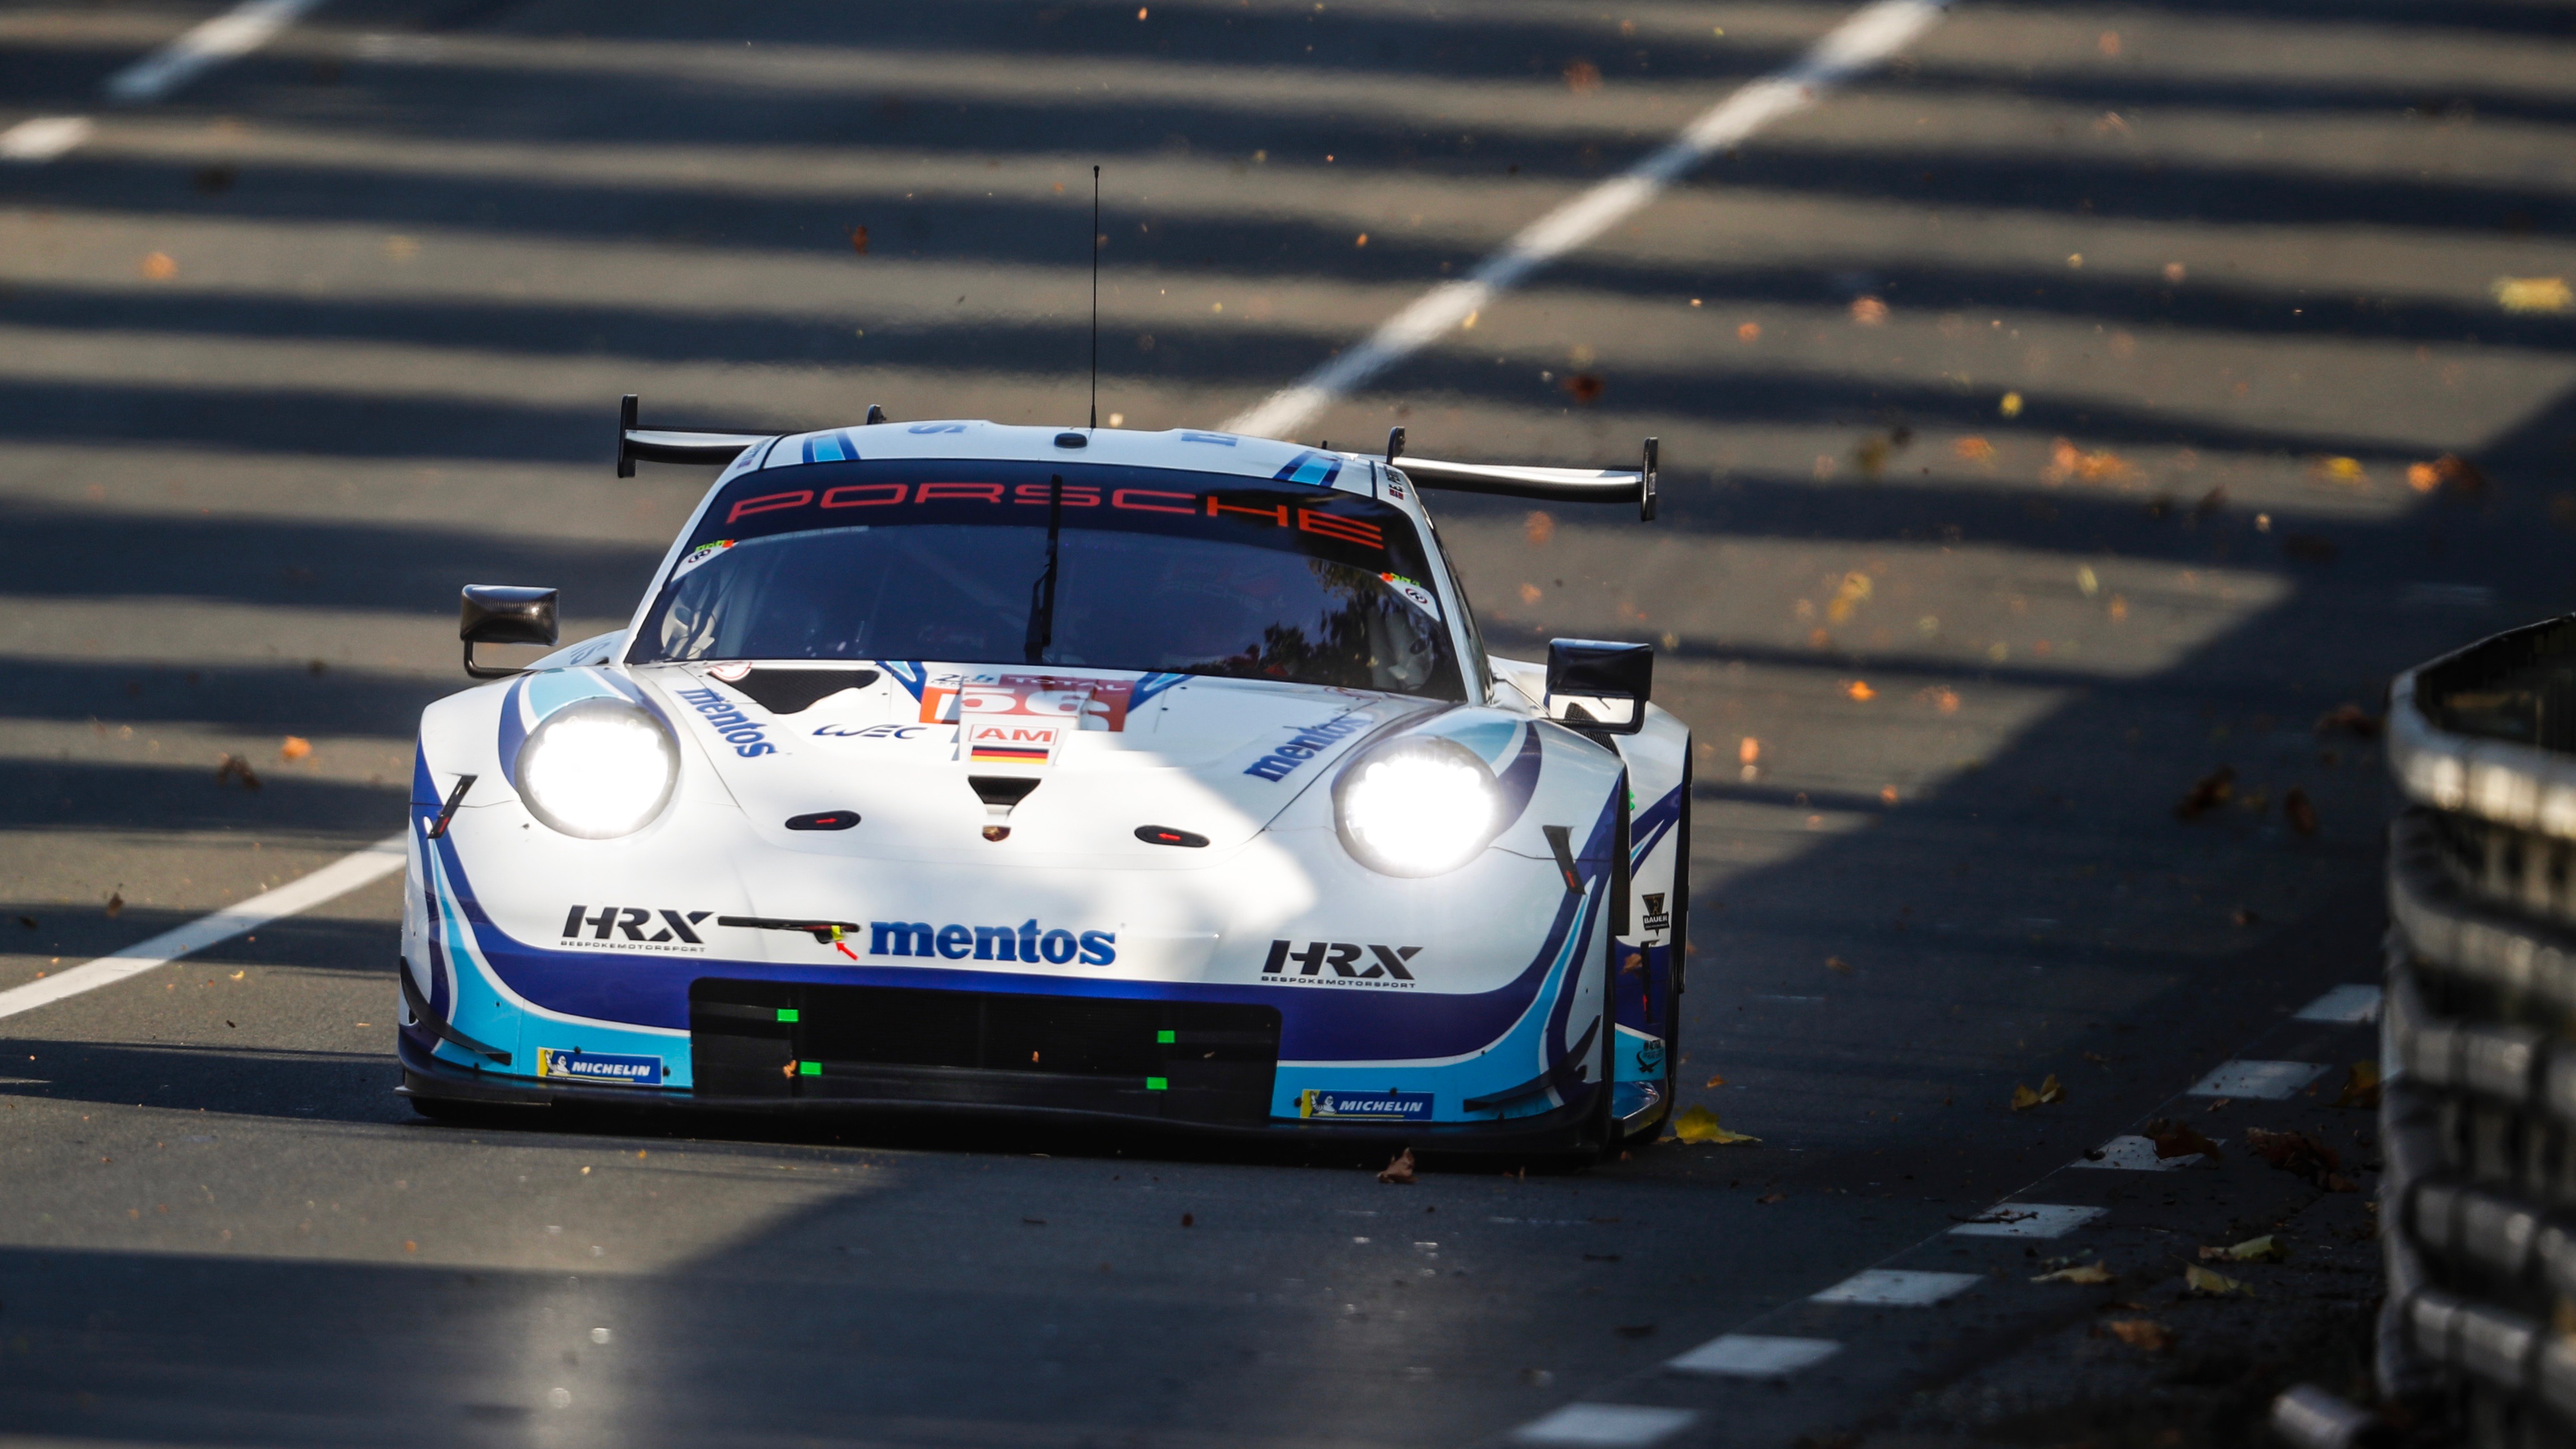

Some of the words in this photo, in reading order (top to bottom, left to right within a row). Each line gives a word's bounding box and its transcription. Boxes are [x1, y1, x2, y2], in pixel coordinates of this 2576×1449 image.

[725, 483, 1384, 550] PORSCHE
[676, 687, 778, 758] mentos
[934, 686, 1111, 732] 56
[812, 724, 927, 739] WEC
[975, 727, 1053, 743] AM
[1243, 716, 1374, 783] mentos
[562, 904, 714, 944] HRX
[1644, 915, 1667, 924] BAUER
[561, 940, 706, 953] BESPOKEMOTORSPORT
[869, 919, 1116, 966] mentos
[1262, 939, 1423, 980] HRX
[1261, 975, 1416, 989] BESPOKEMOTORSPORT
[572, 1062, 650, 1077] MICHELIN
[1339, 1100, 1423, 1112] MICHELIN
